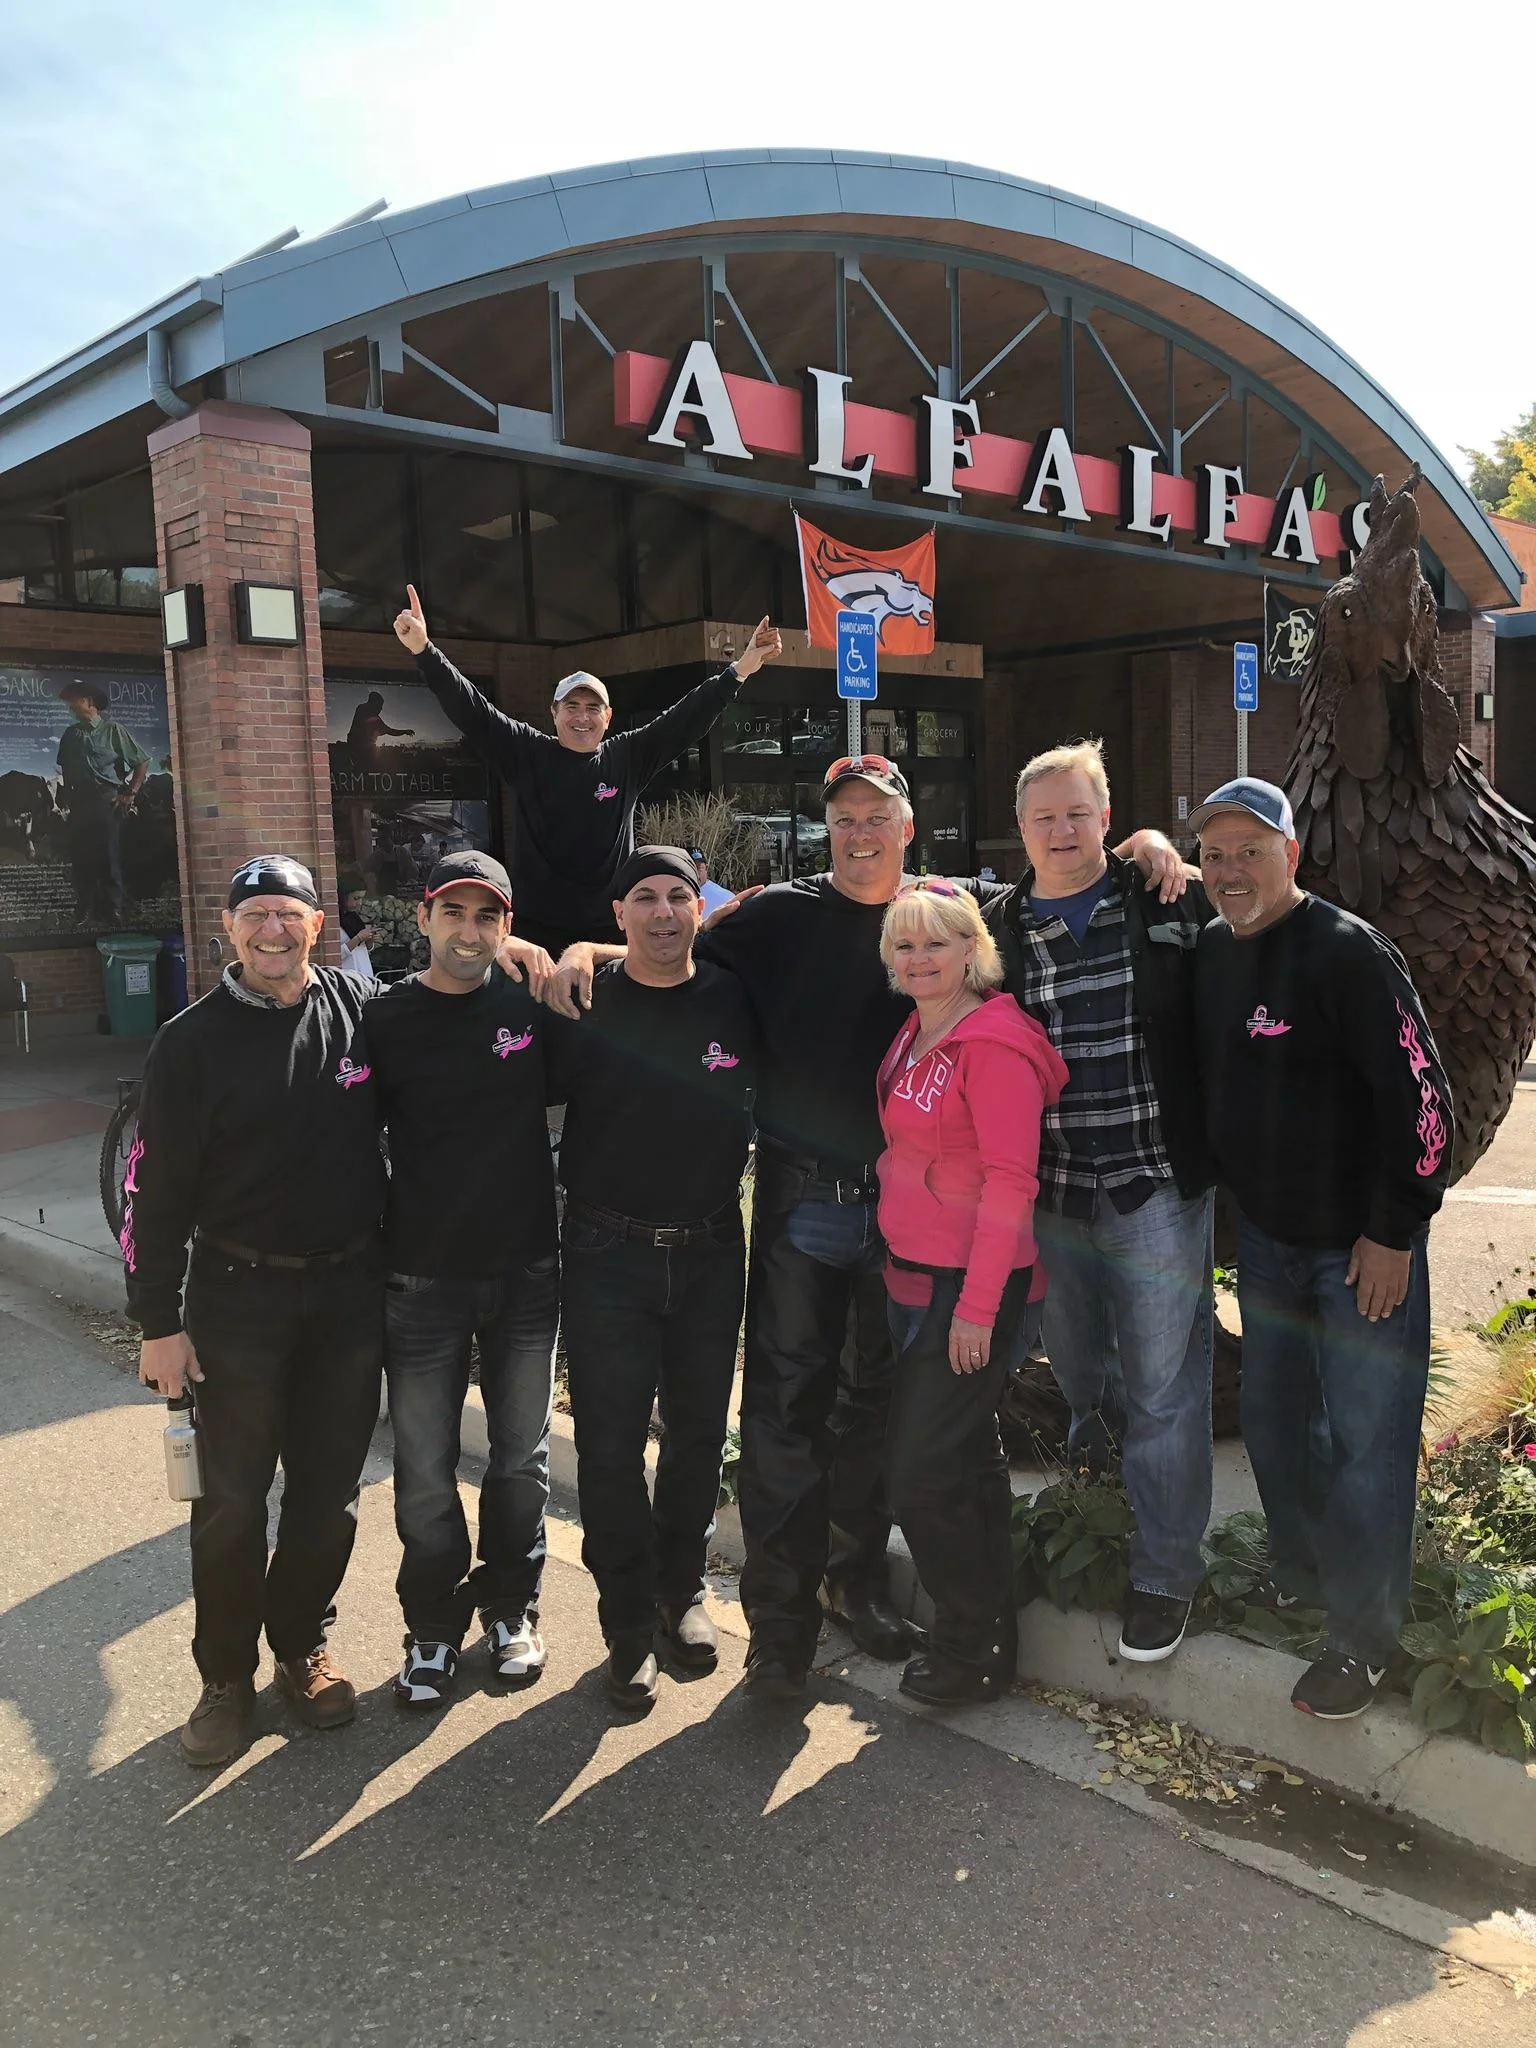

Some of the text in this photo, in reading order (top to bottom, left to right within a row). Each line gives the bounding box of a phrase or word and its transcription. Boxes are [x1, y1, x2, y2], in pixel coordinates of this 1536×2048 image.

[840, 621, 873, 635] HANDICAPPED
[844, 676, 870, 689] PARKING
[108, 681, 158, 702] DAIRY
[734, 722, 959, 738] YOUR LOCAL OMMUNITY GROCERY
[330, 772, 454, 792] ARM TO TABLE
